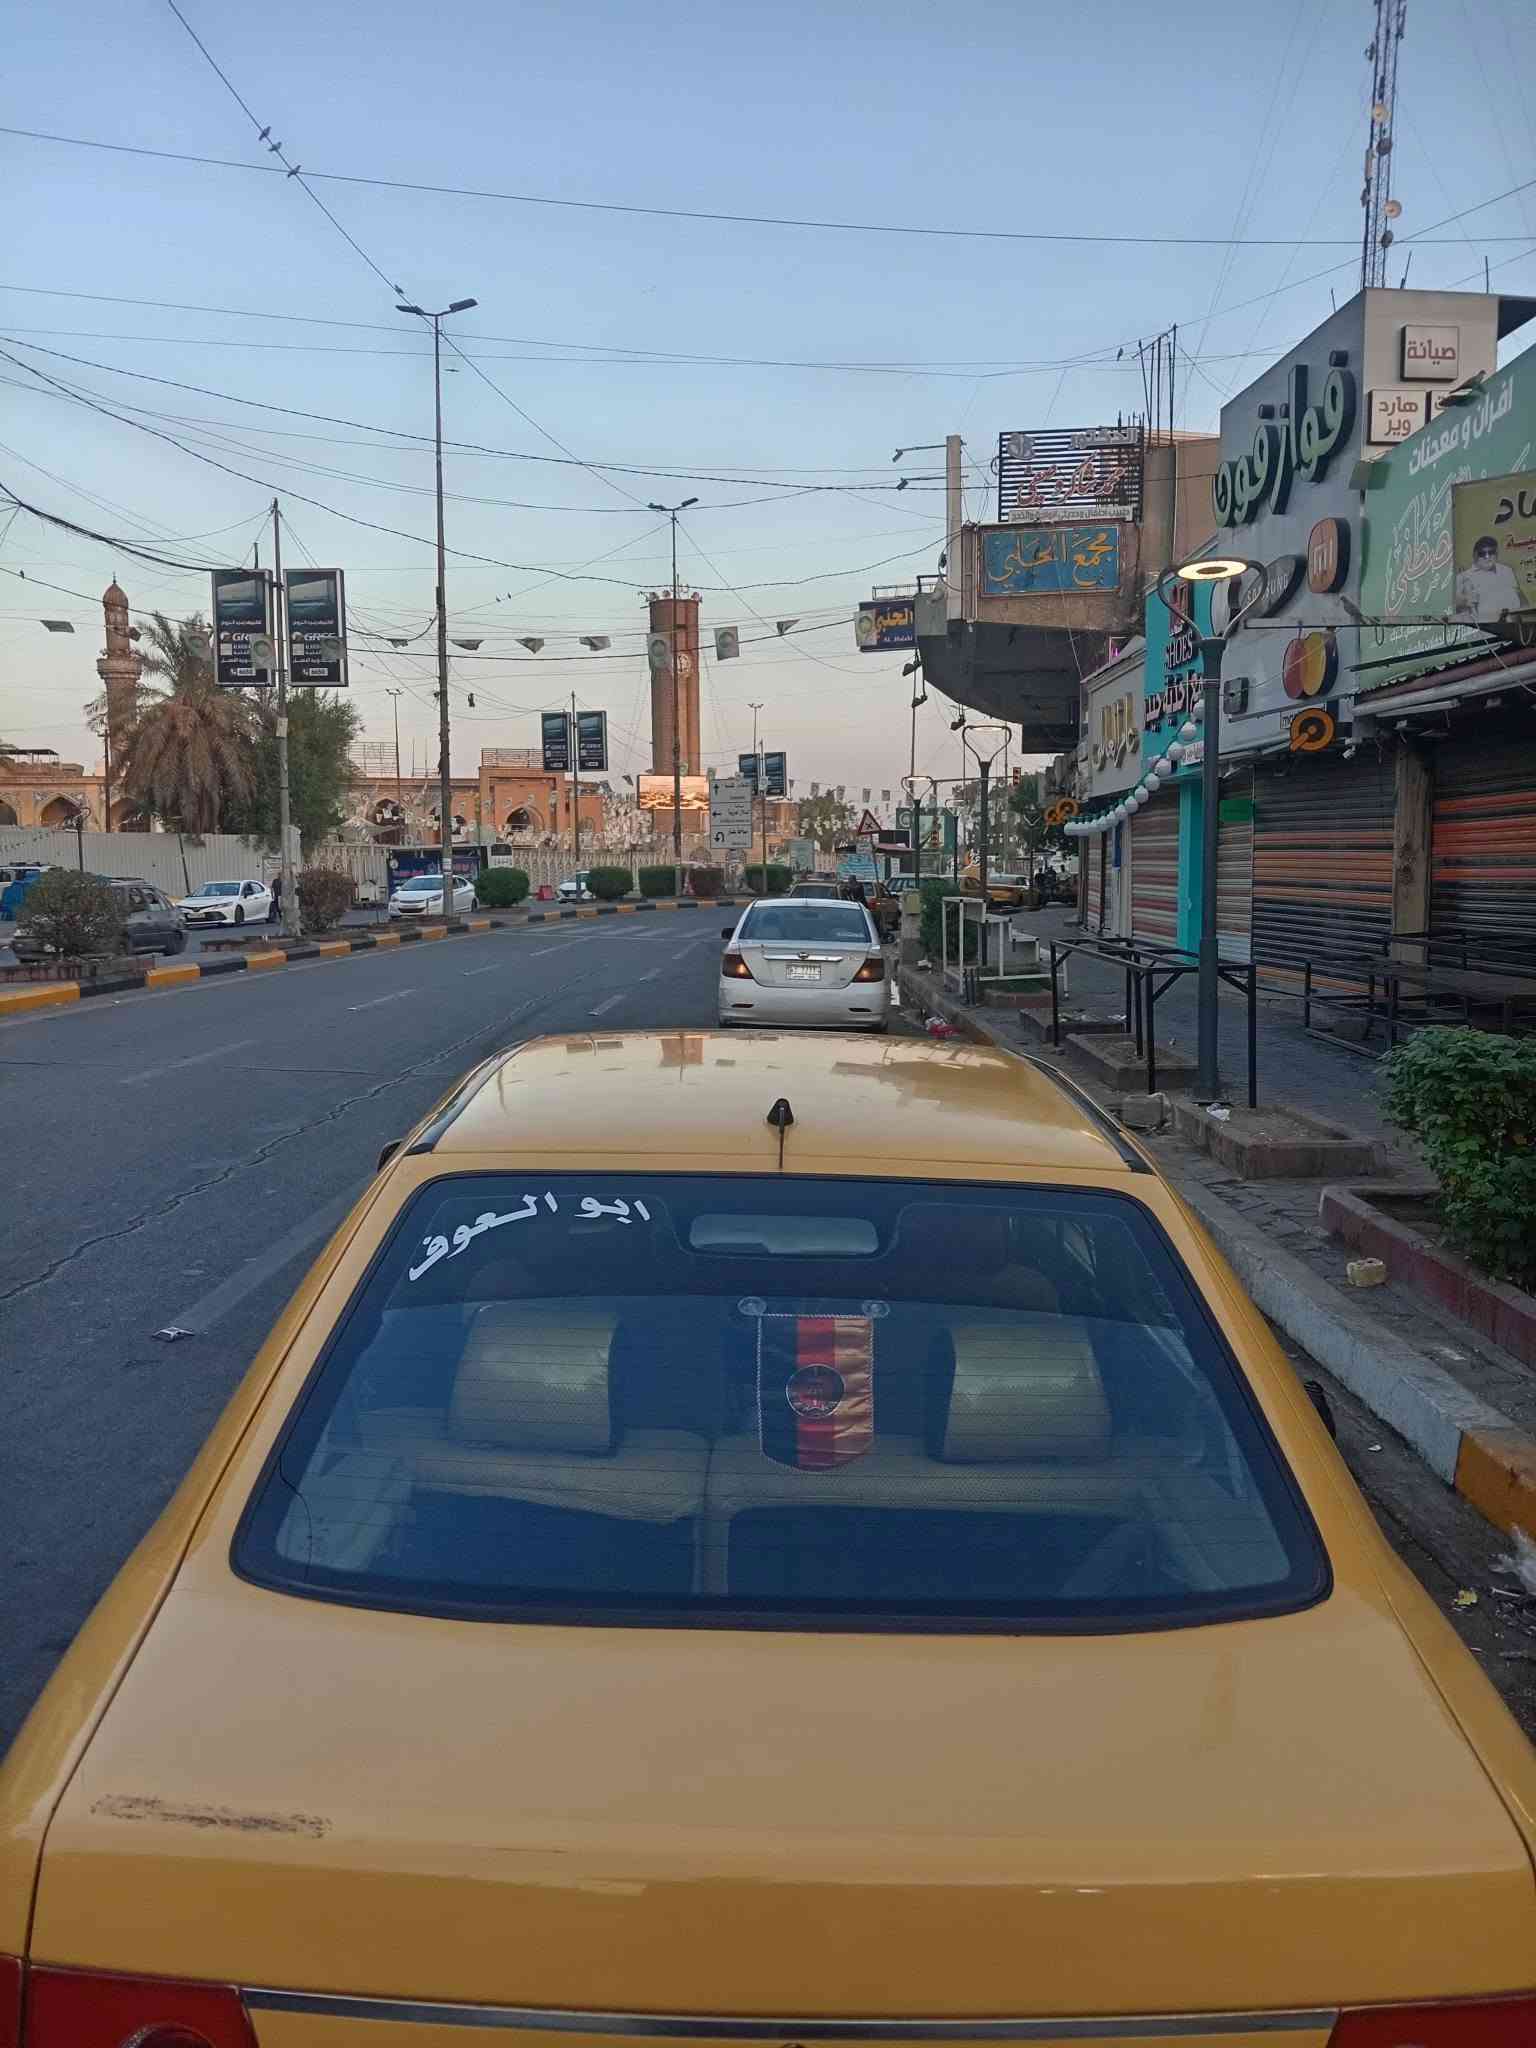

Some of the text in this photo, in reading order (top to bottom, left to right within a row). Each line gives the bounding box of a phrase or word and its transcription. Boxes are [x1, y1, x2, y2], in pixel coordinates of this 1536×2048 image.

[1407, 339, 1457, 366] صيانة
[1378, 395, 1418, 417] هارد
[1384, 417, 1412, 437] وير
[1072, 532, 1115, 588] مجمع
[408, 1191, 652, 1282] ابو العوف
